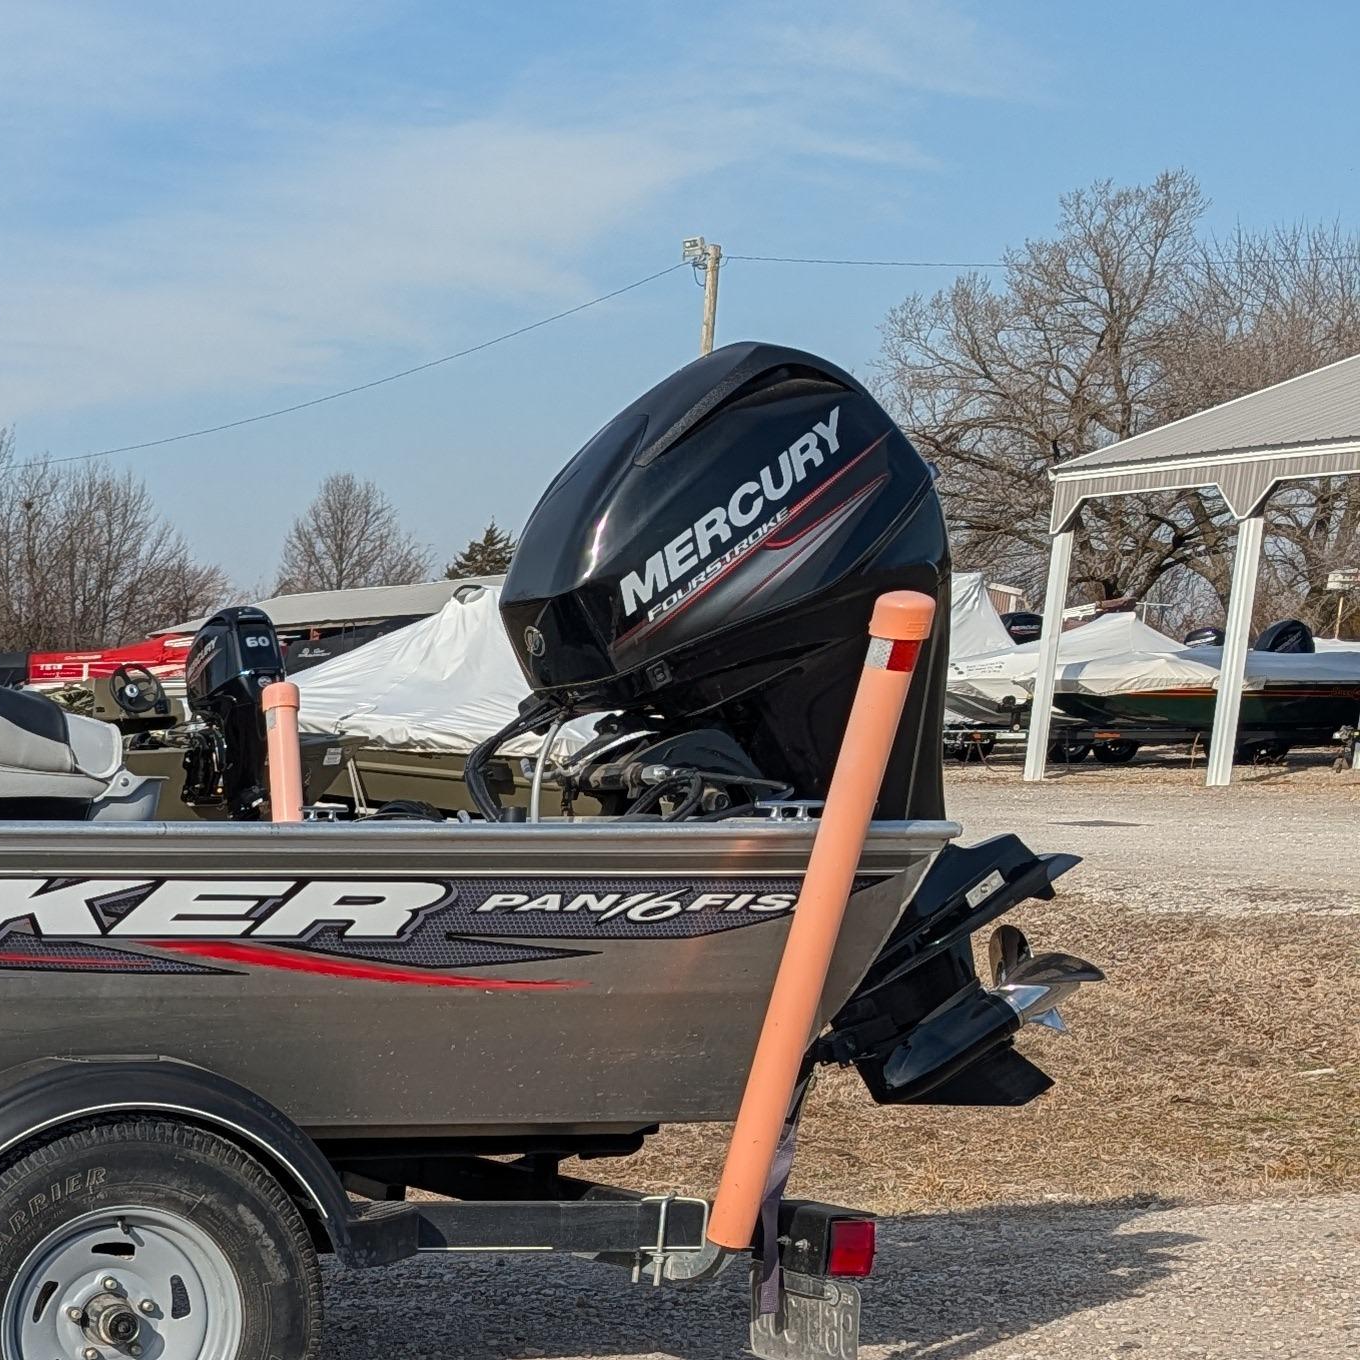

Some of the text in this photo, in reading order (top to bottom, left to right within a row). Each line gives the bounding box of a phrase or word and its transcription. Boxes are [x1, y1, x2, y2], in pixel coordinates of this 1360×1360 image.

[619, 405, 840, 617] MERCURY
[648, 506, 790, 623] FOURSTROKE
[245, 636, 270, 648] 60
[684, 893, 798, 912] FIS
